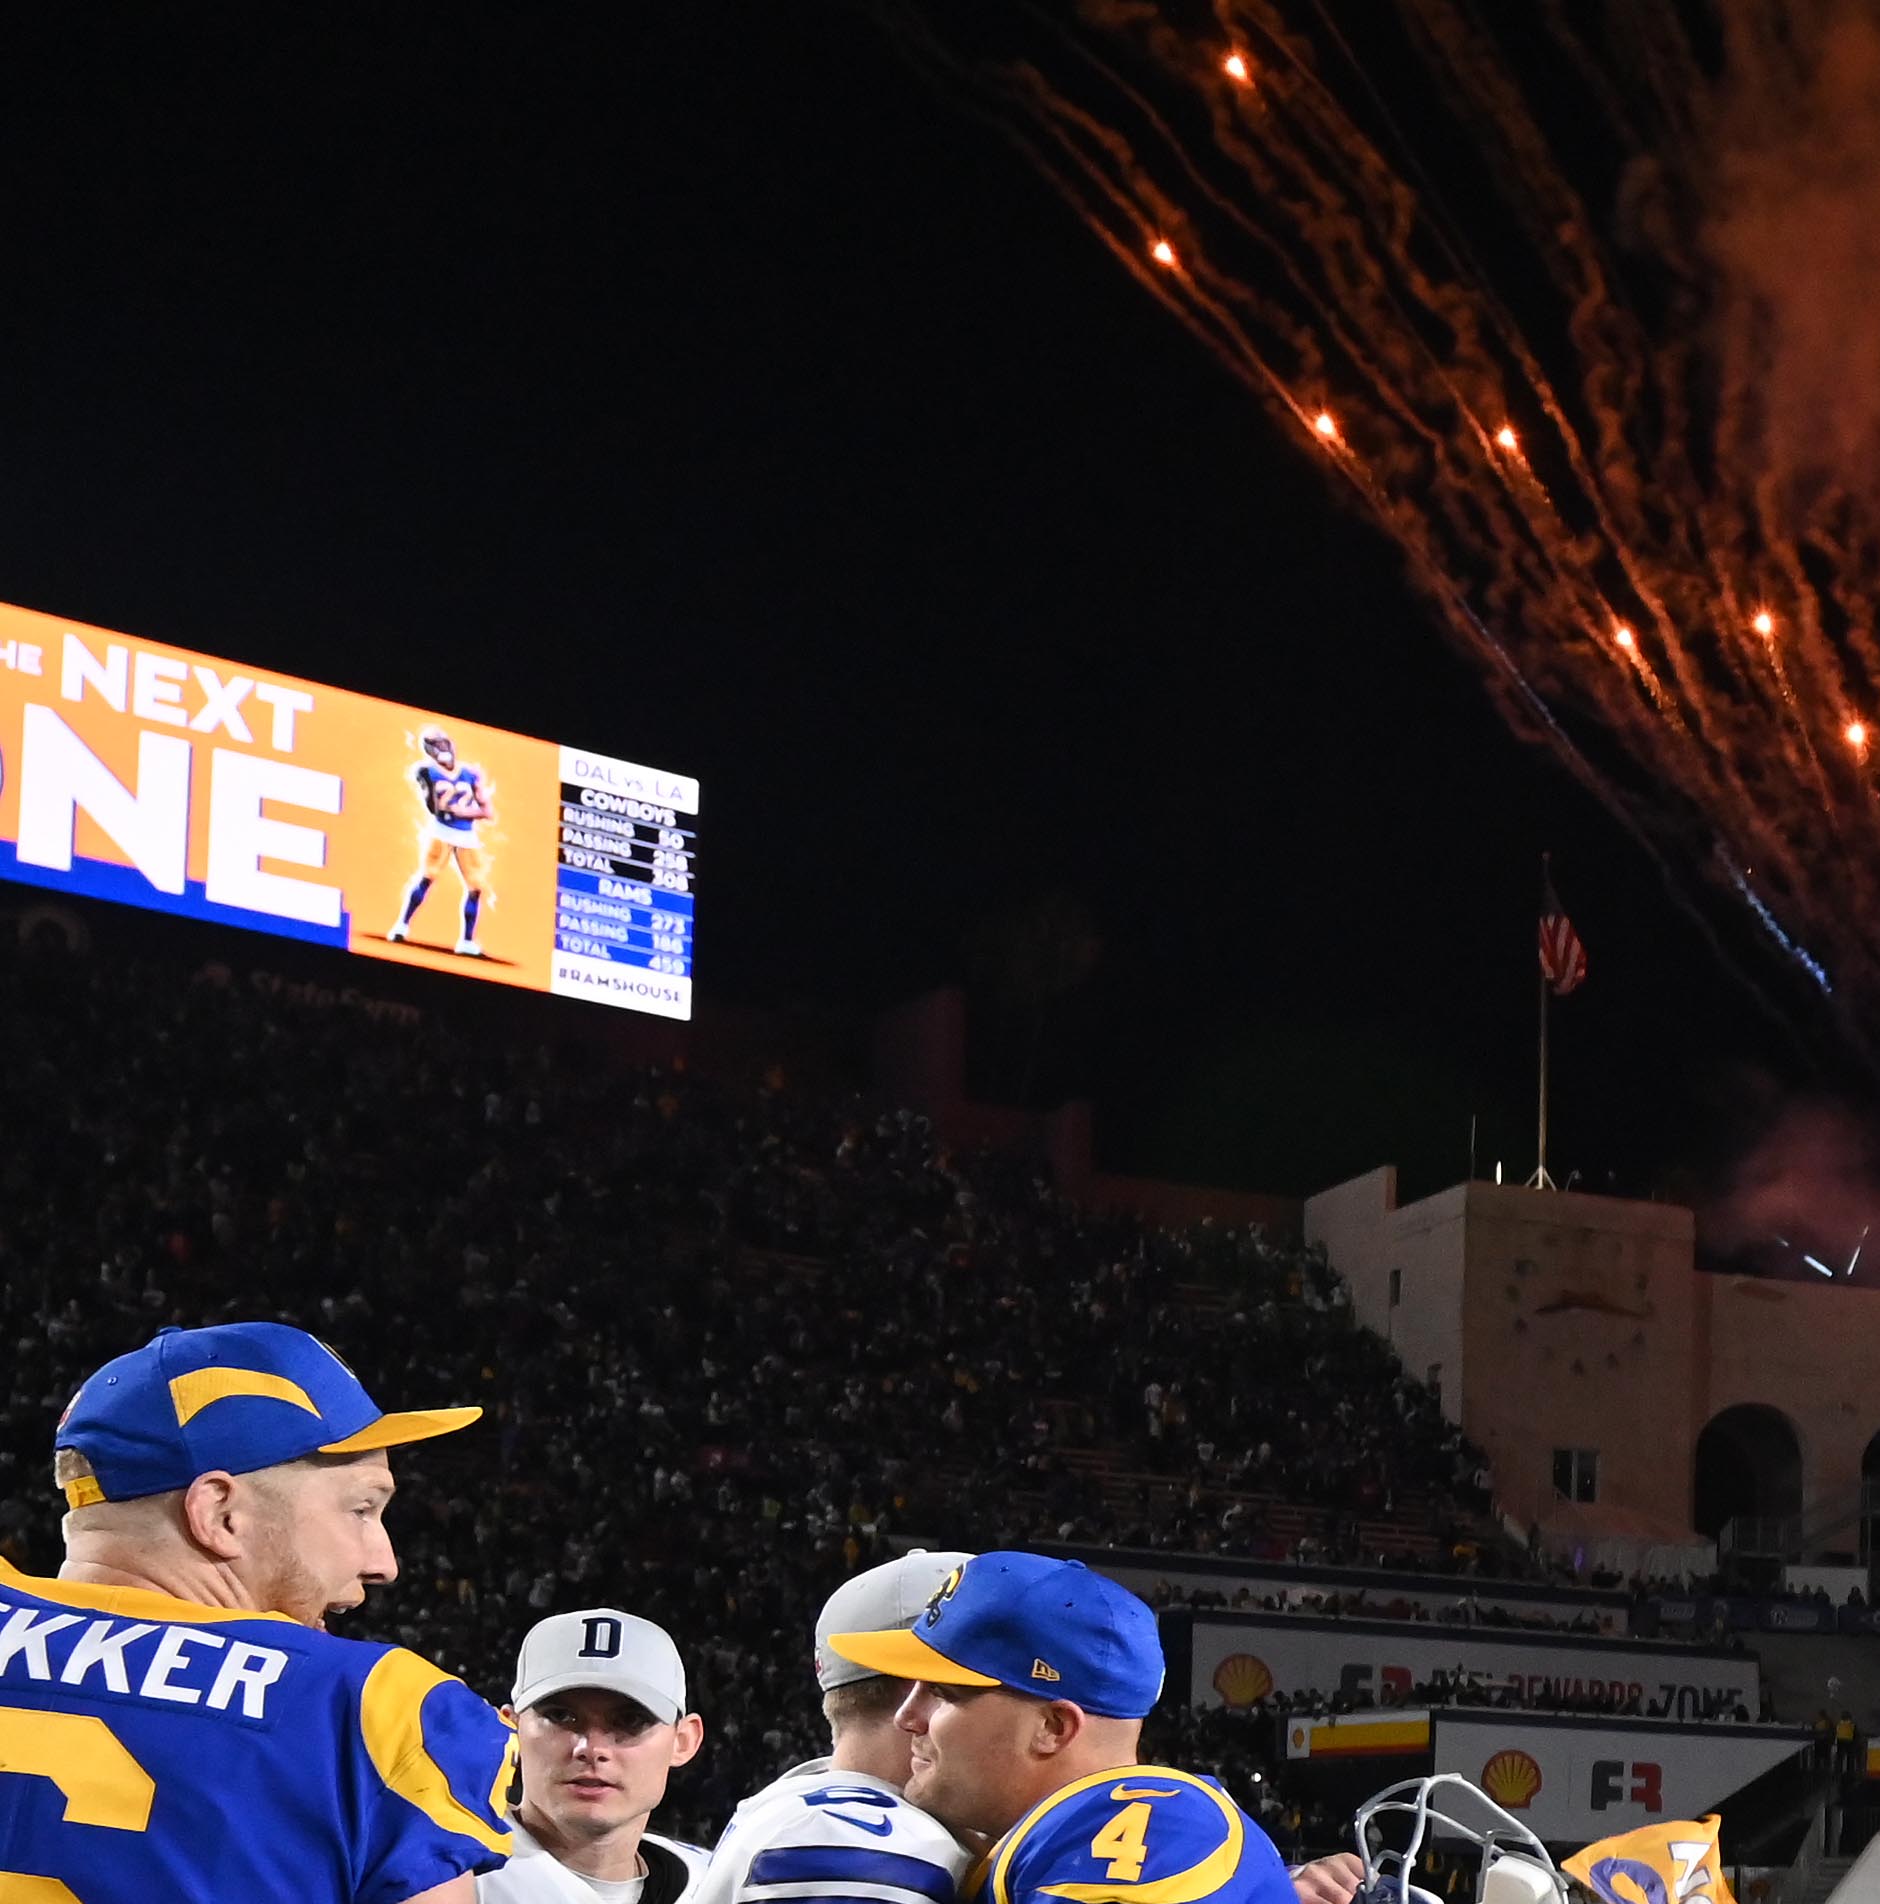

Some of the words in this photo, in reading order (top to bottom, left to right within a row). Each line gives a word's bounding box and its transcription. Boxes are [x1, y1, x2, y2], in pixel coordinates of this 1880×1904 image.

[61, 633, 316, 753] NEXT
[575, 759, 619, 786] DAL
[655, 780, 684, 801] LA
[16, 702, 343, 928] NE
[563, 807, 636, 838] RUSHING
[580, 788, 677, 827] COWBOYS
[562, 828, 632, 858] PASSING
[563, 848, 615, 874] TOTAL
[560, 893, 633, 923] RUSHING
[598, 879, 653, 906] RAMS
[559, 913, 629, 943] PASSING
[560, 933, 612, 960] TOTAL
[558, 967, 681, 1003] #RAMSHOUSE
[578, 1617, 625, 1660] D
[1091, 1801, 1152, 1883] 4
